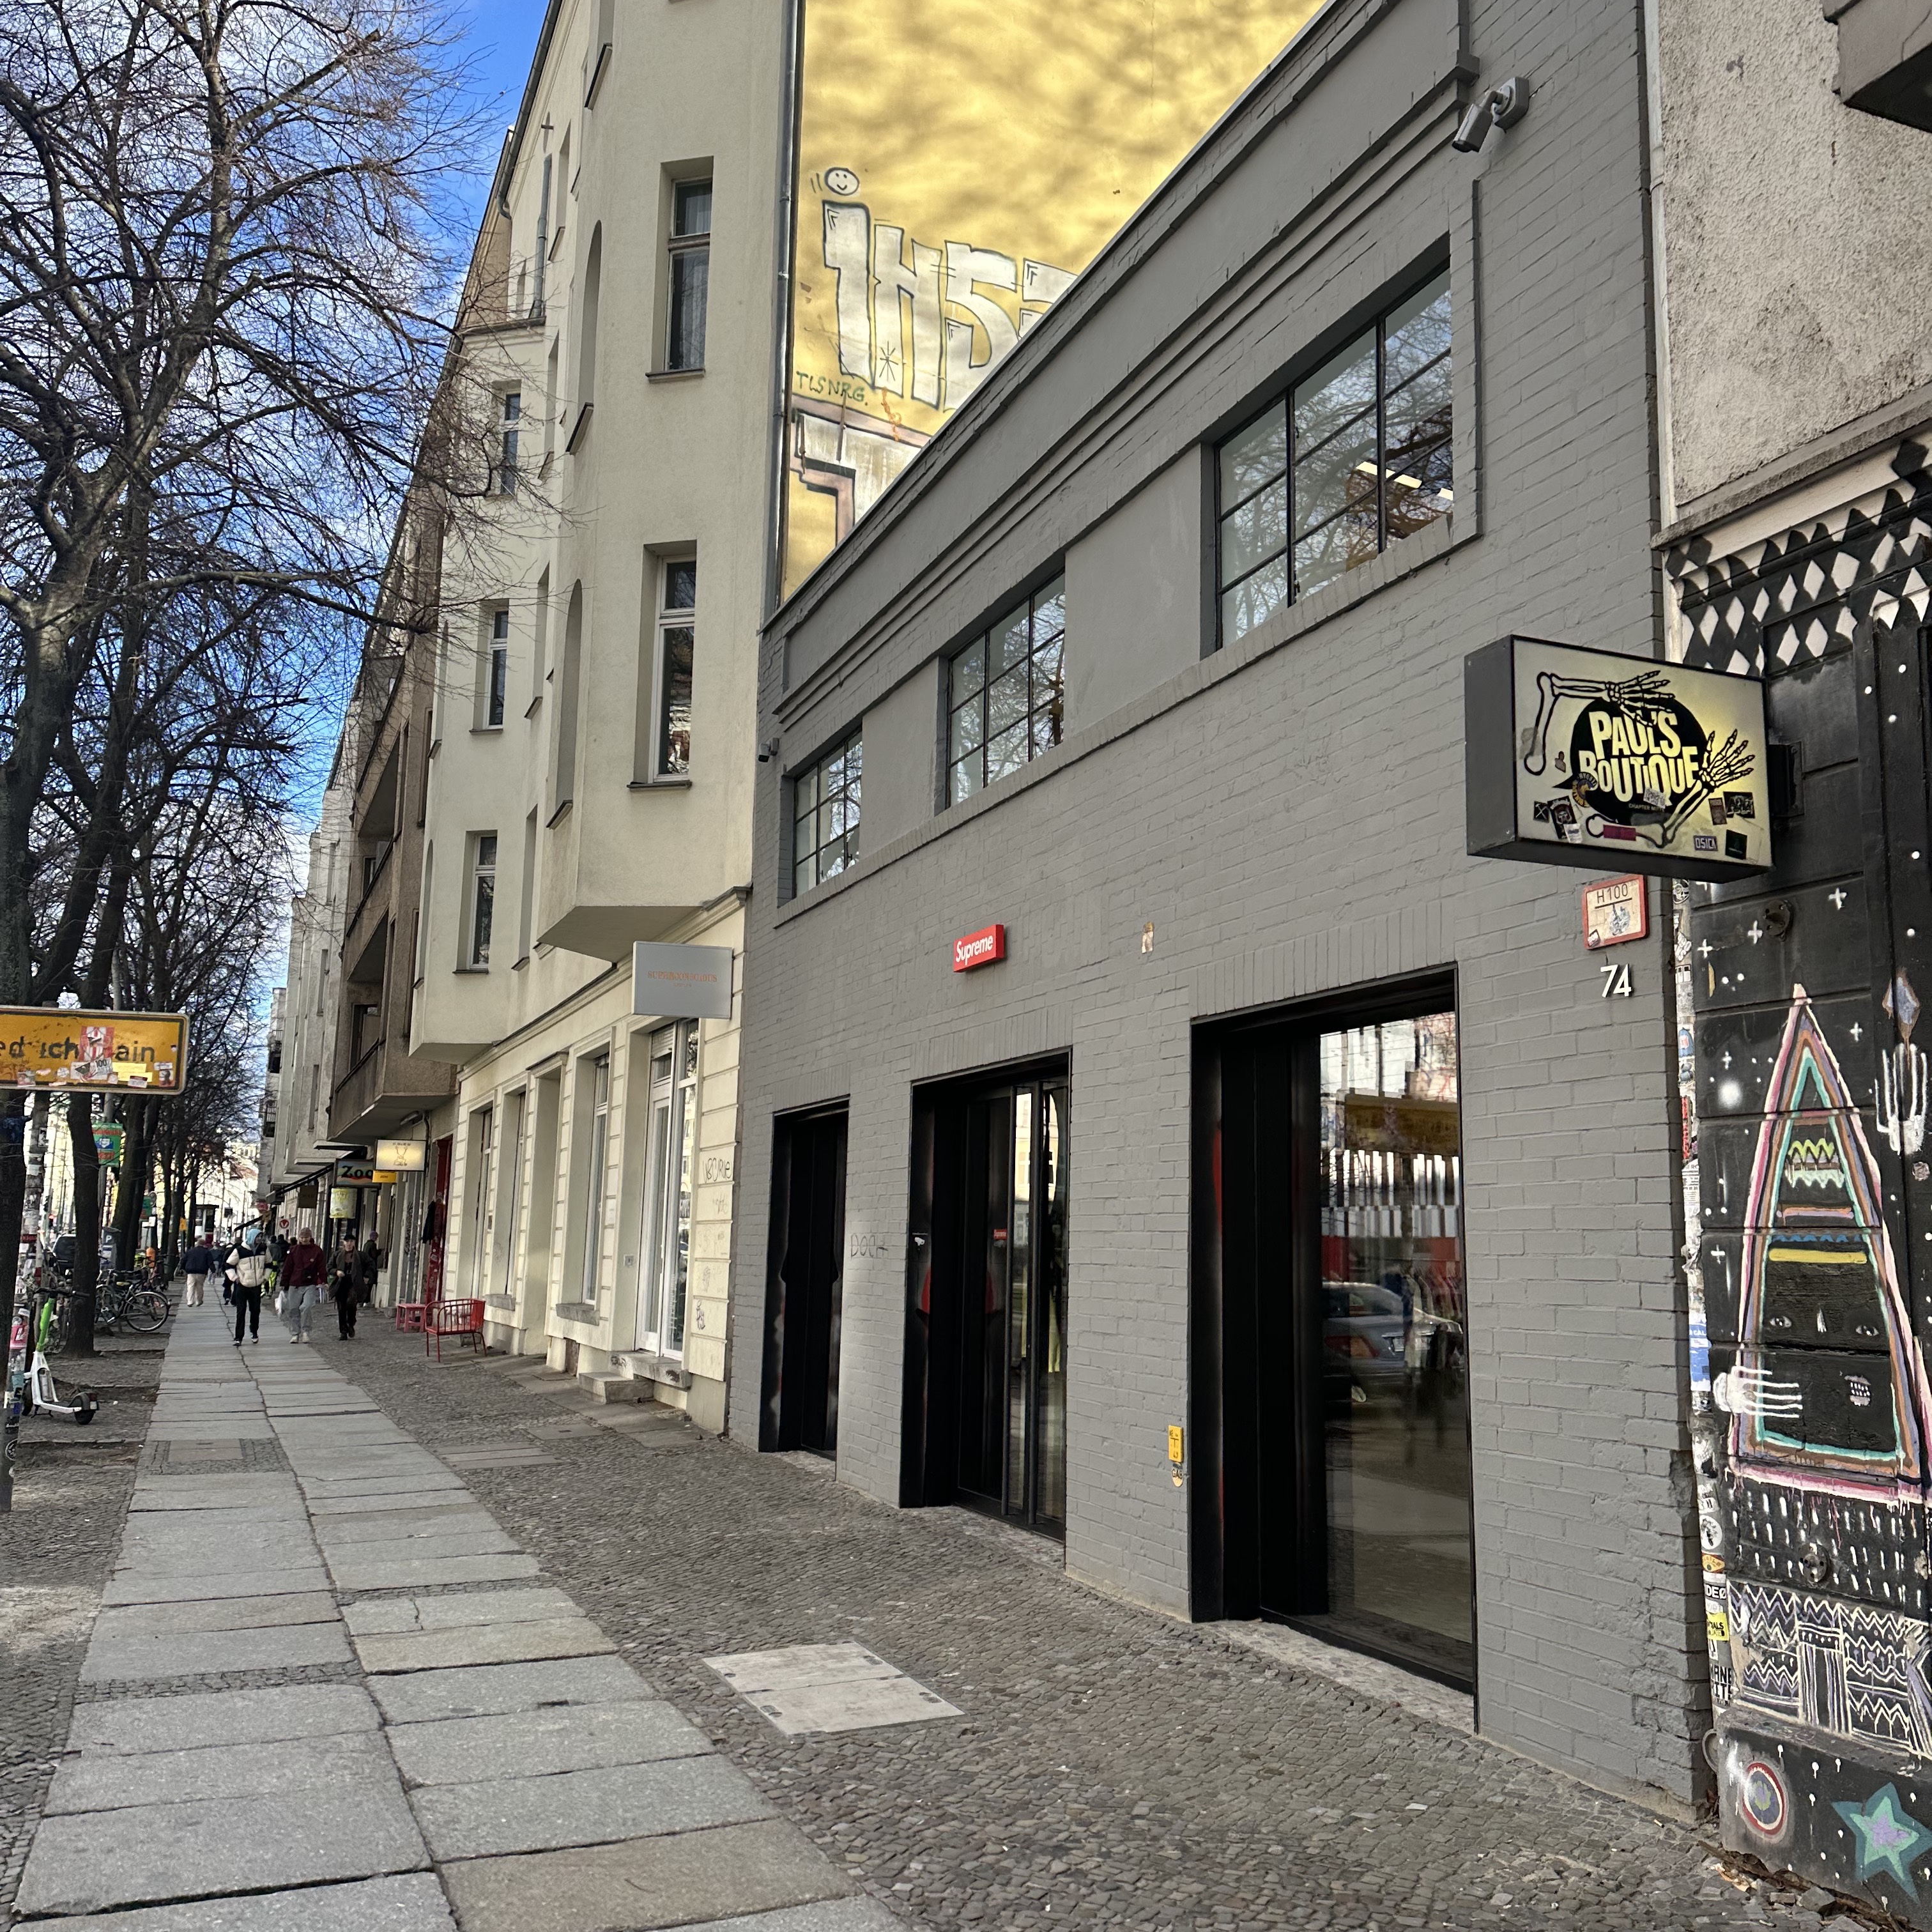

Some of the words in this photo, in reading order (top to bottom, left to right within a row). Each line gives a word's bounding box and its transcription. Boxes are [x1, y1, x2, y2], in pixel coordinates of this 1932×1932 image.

[1589, 710, 1682, 760] PAUL'S
[1579, 746, 1699, 806] BOUTIQUE
[955, 935, 993, 966] Supreme
[1600, 963, 1632, 998] 74
